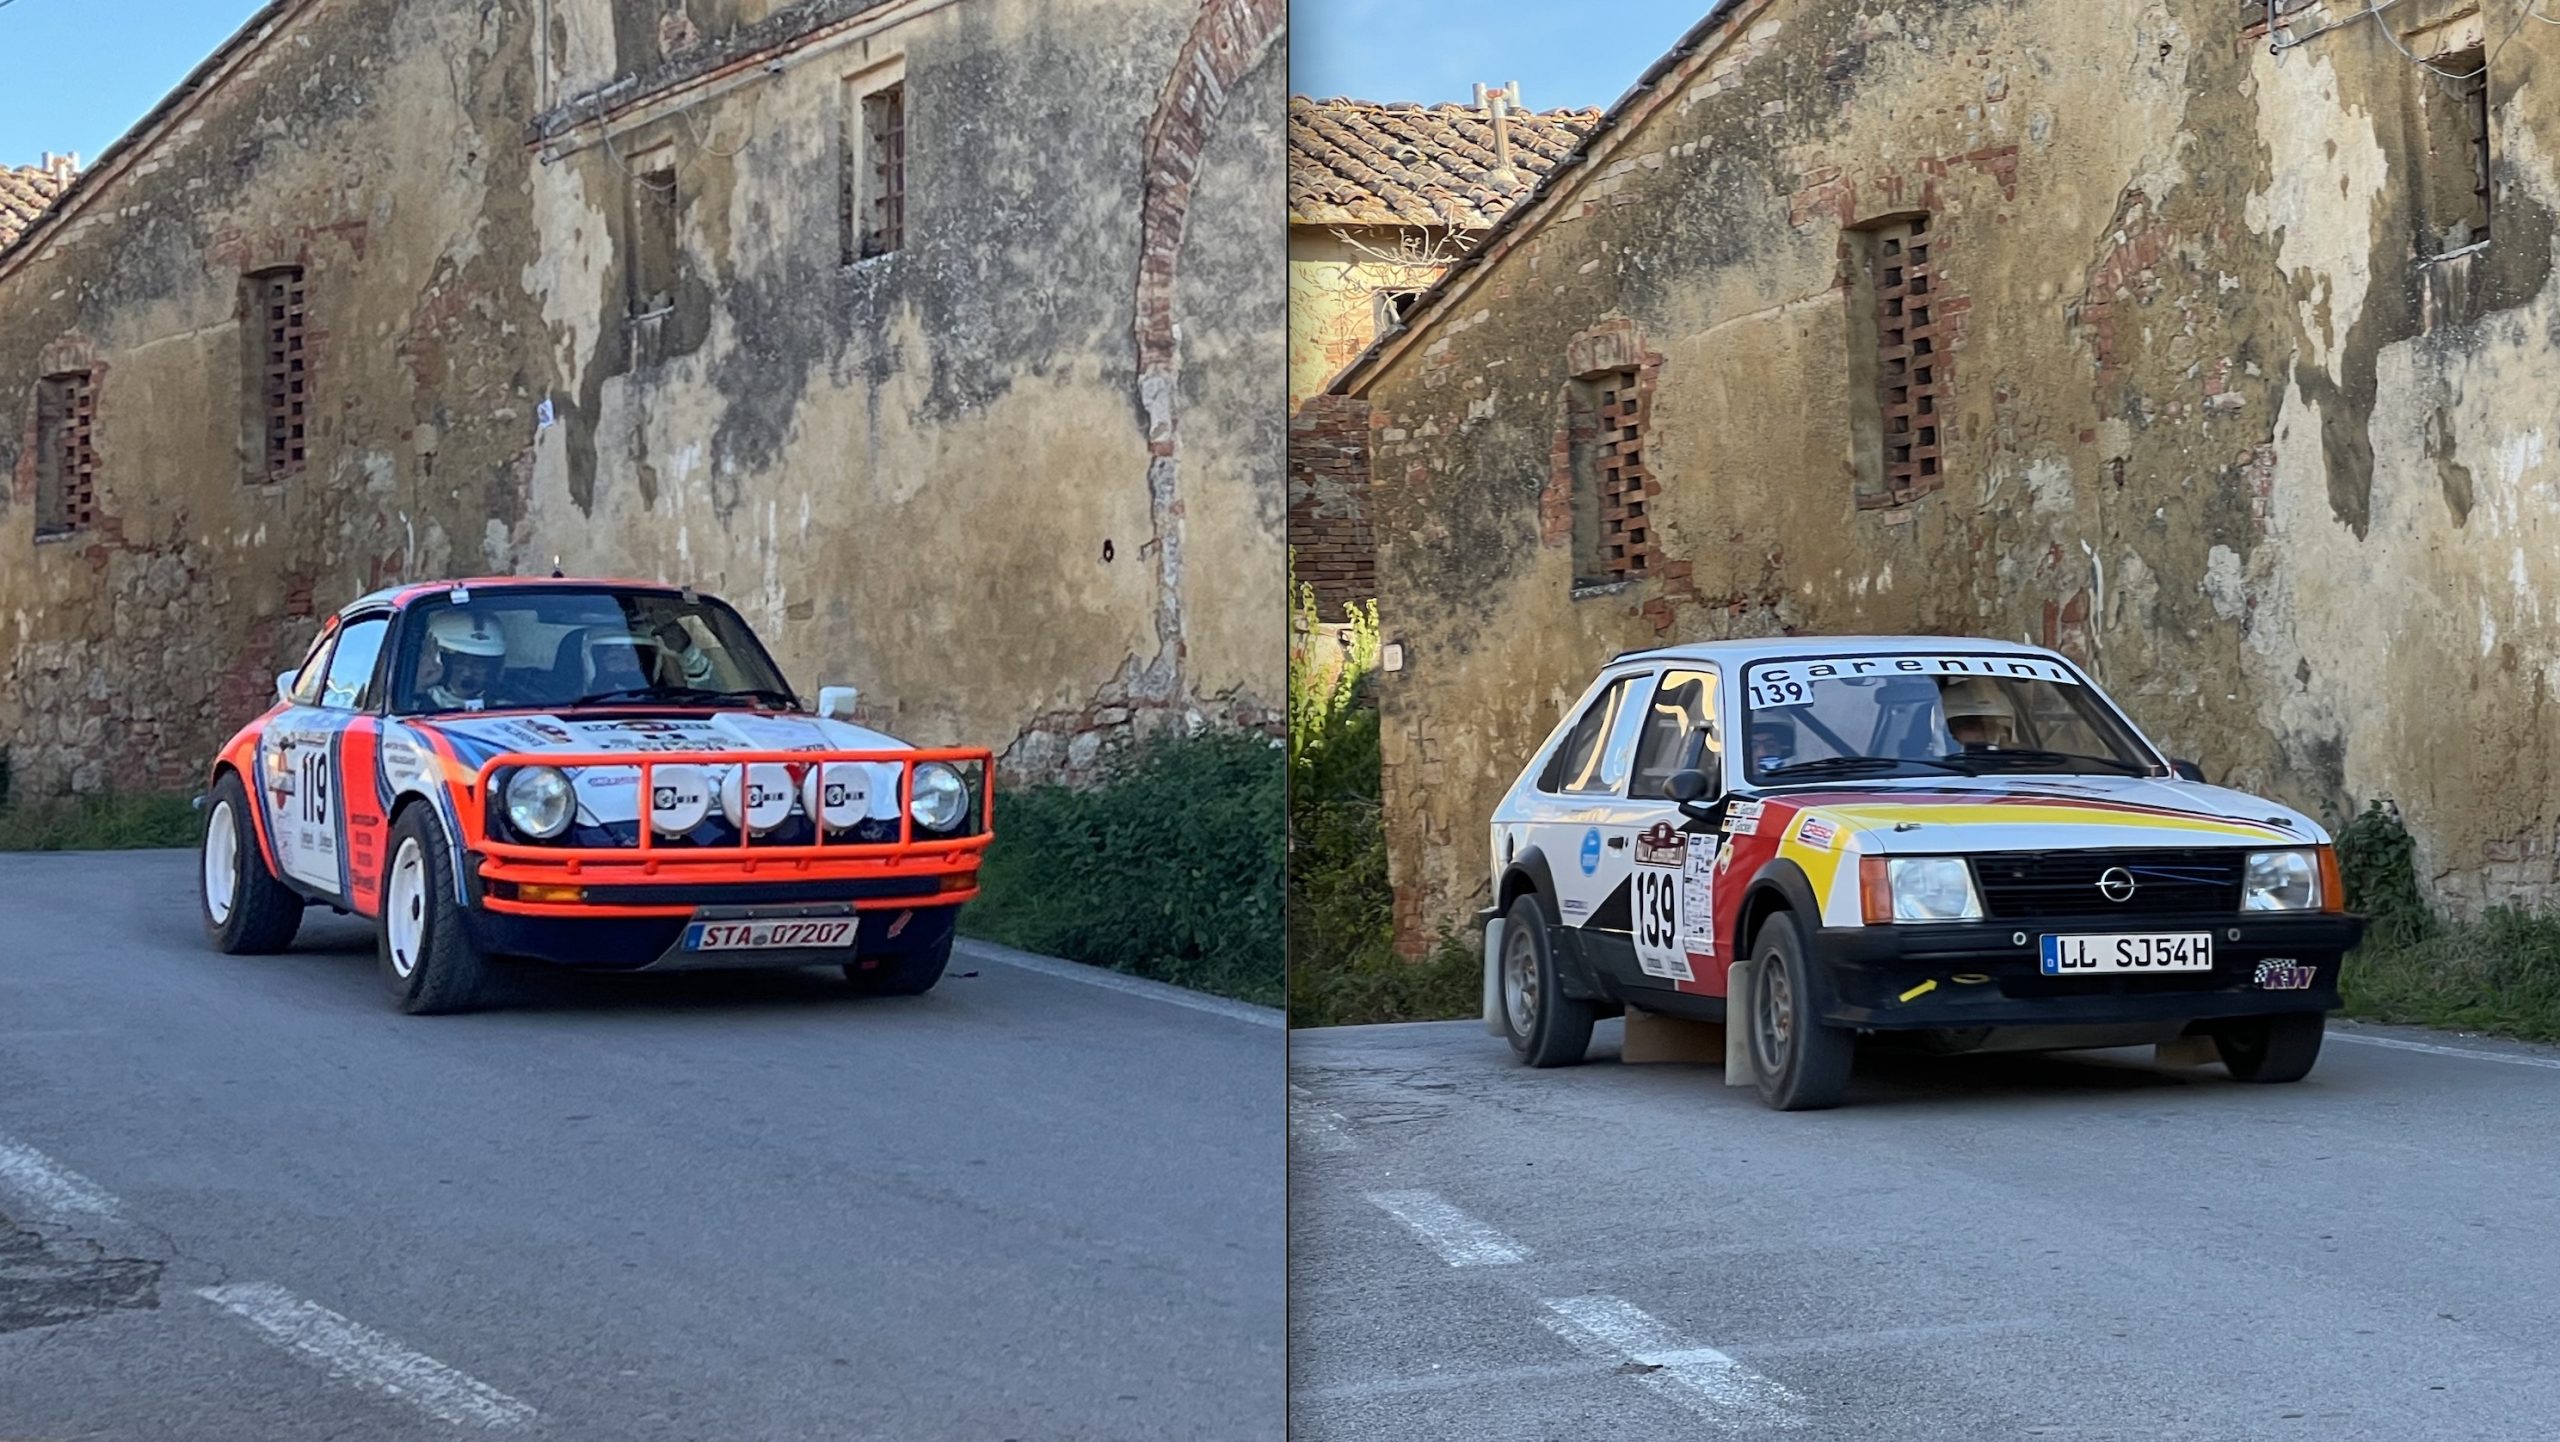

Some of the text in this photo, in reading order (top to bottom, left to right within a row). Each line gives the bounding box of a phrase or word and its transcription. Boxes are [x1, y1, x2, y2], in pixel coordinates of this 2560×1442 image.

[1750, 682, 1803, 705] 139
[302, 752, 327, 825] 119
[1637, 871, 1676, 950] 139
[703, 923, 850, 947] STA 07207
[2060, 940, 2097, 968] LL
[2263, 966, 2317, 990] KW
